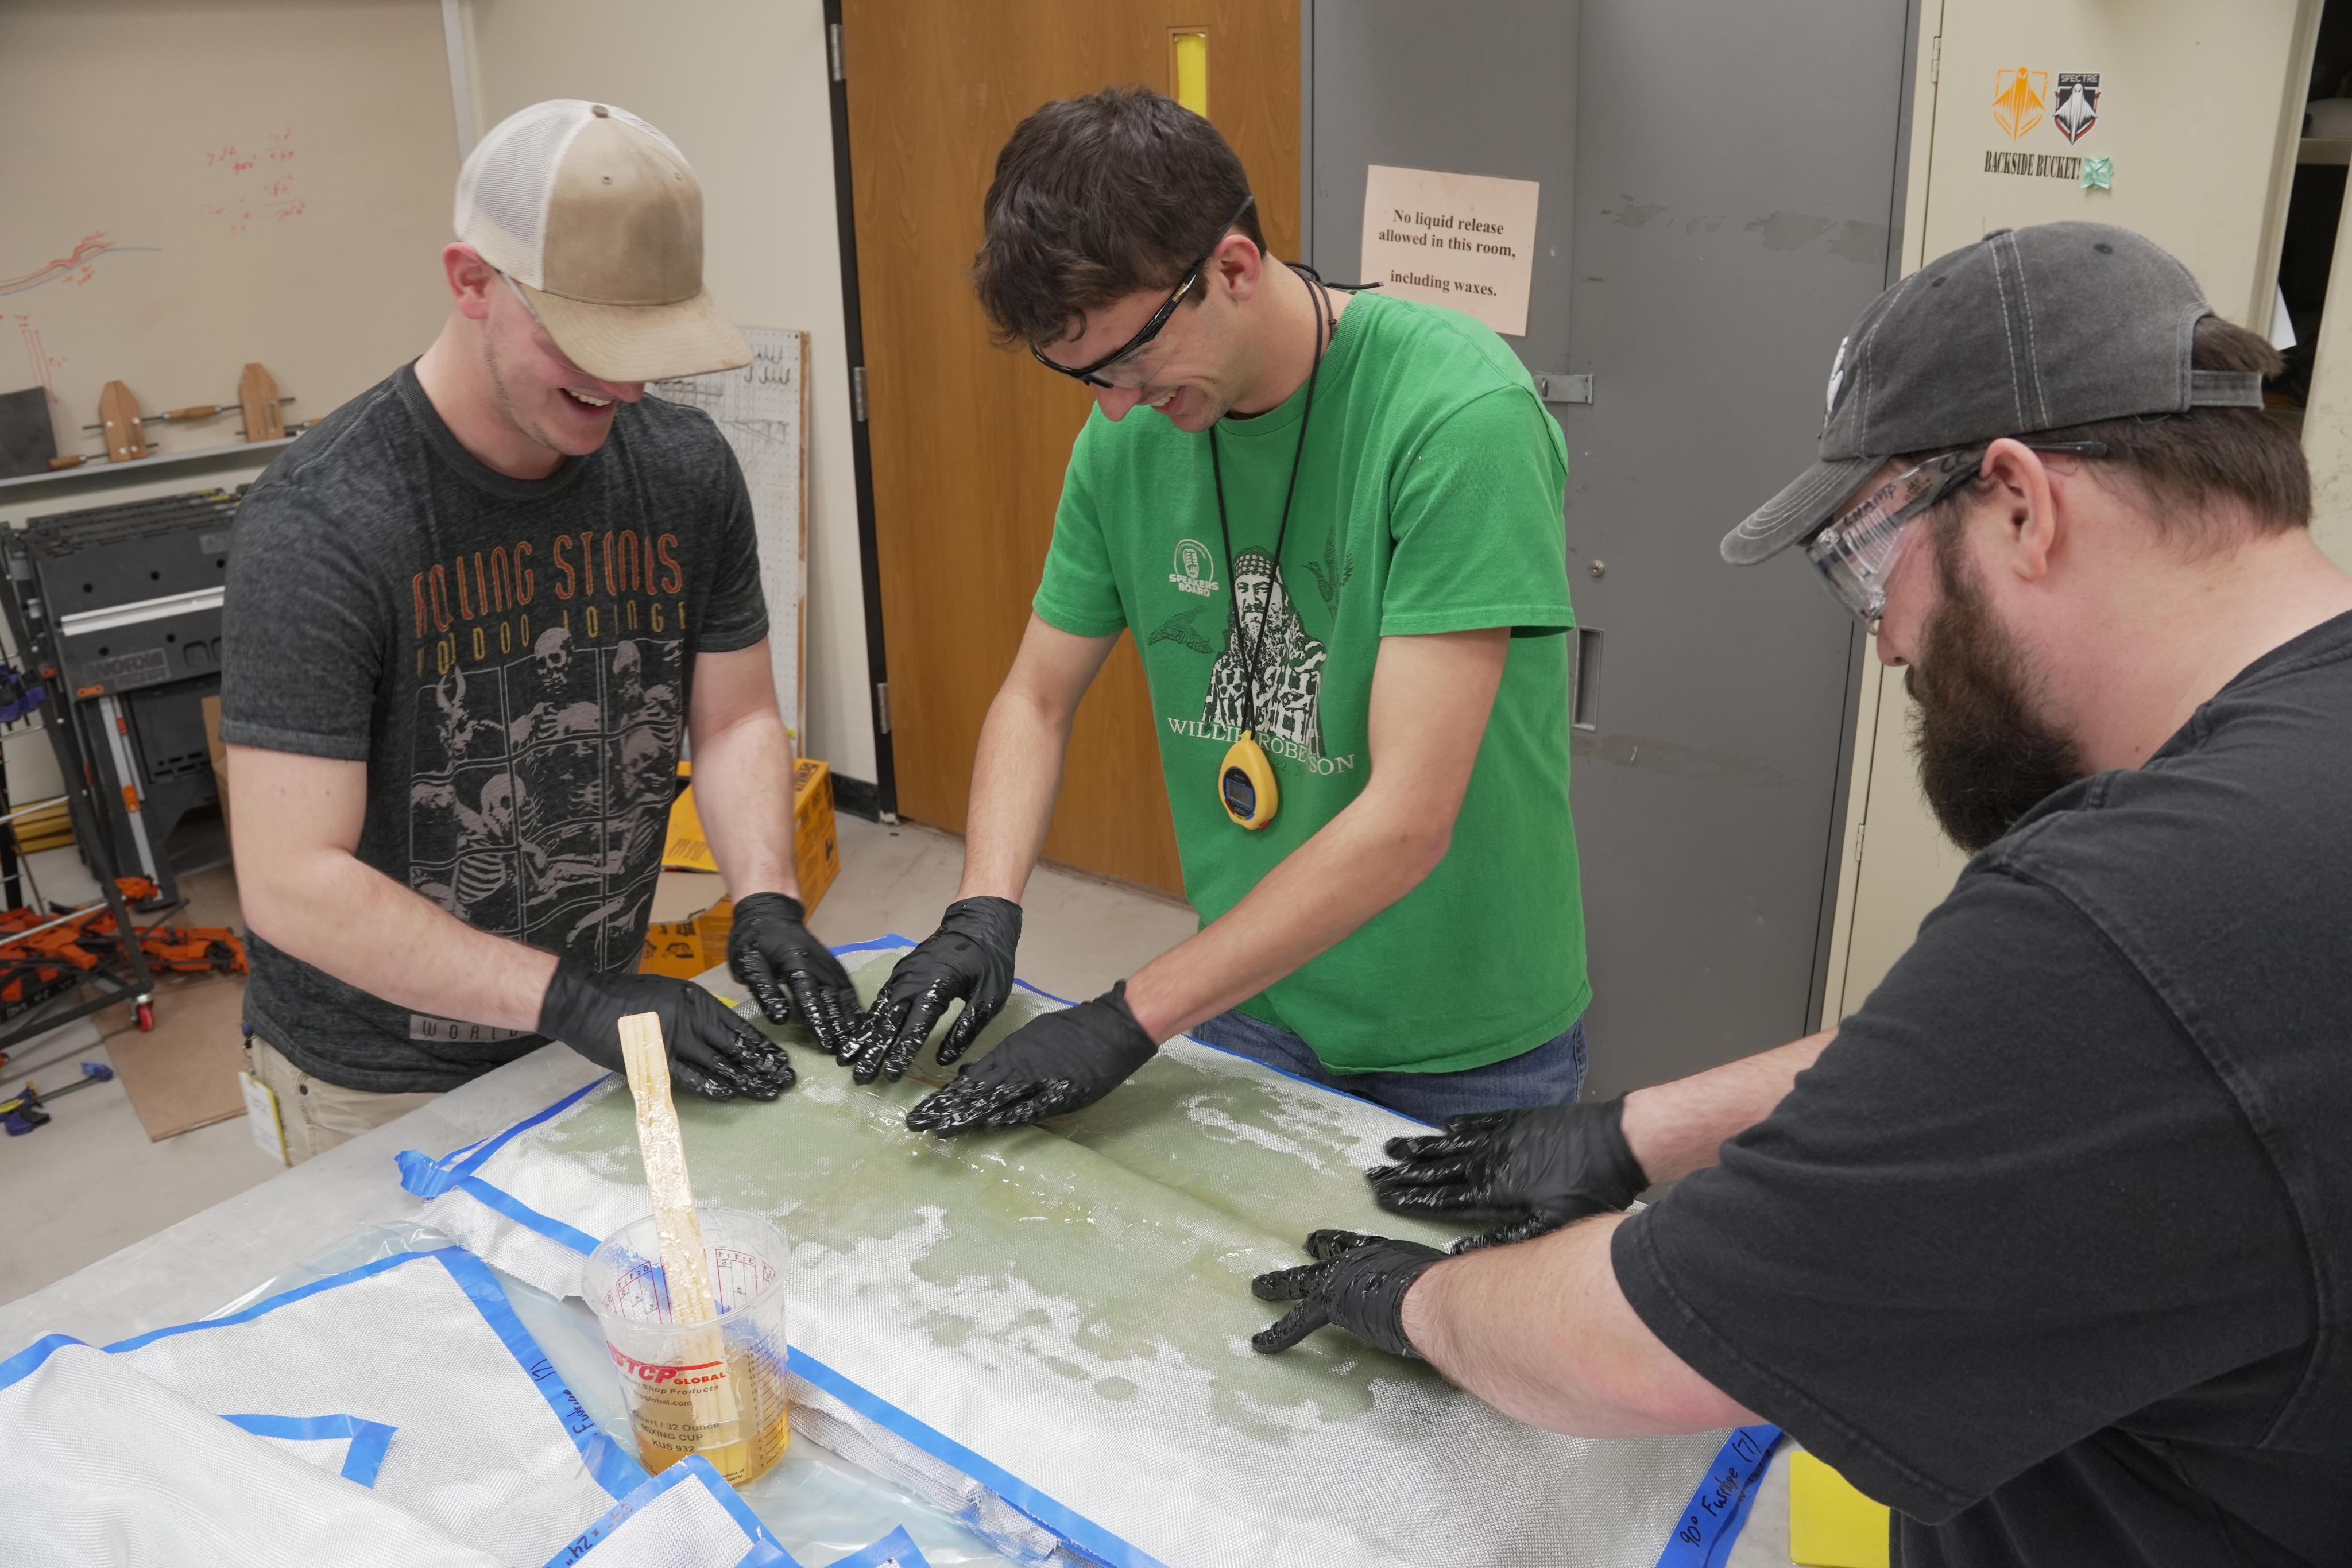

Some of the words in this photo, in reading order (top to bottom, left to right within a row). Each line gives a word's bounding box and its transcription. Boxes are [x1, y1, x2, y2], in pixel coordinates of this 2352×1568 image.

[2060, 74, 2098, 83] SPECTRE
[1984, 150, 2035, 176] BACKSIDE
[2036, 154, 2082, 180] BUCKET!
[1393, 209, 1411, 223] No
[1415, 212, 1453, 230] liquid
[1458, 218, 1504, 234] release
[1379, 229, 1427, 246] allowed
[1431, 234, 1443, 247] in
[1448, 237, 1472, 251] this
[1476, 242, 1516, 260] room,
[1390, 269, 1450, 293] including
[1454, 281, 1497, 296] waxes.
[1169, 574, 1220, 591] SPEAKERS
[1178, 582, 1211, 597] BOARD
[674, 1372, 726, 1385] GLOBAL
[633, 1390, 693, 1406] tcpglobal.com
[643, 1384, 667, 1395] Shop
[670, 1385, 719, 1395] Products
[632, 1410, 658, 1427] Quart
[666, 1423, 679, 1431] 32
[682, 1423, 720, 1431] Ounce
[641, 1423, 675, 1440] MIXING
[652, 1439, 673, 1450] KUS
[1732, 1430, 1762, 1462] (7)
